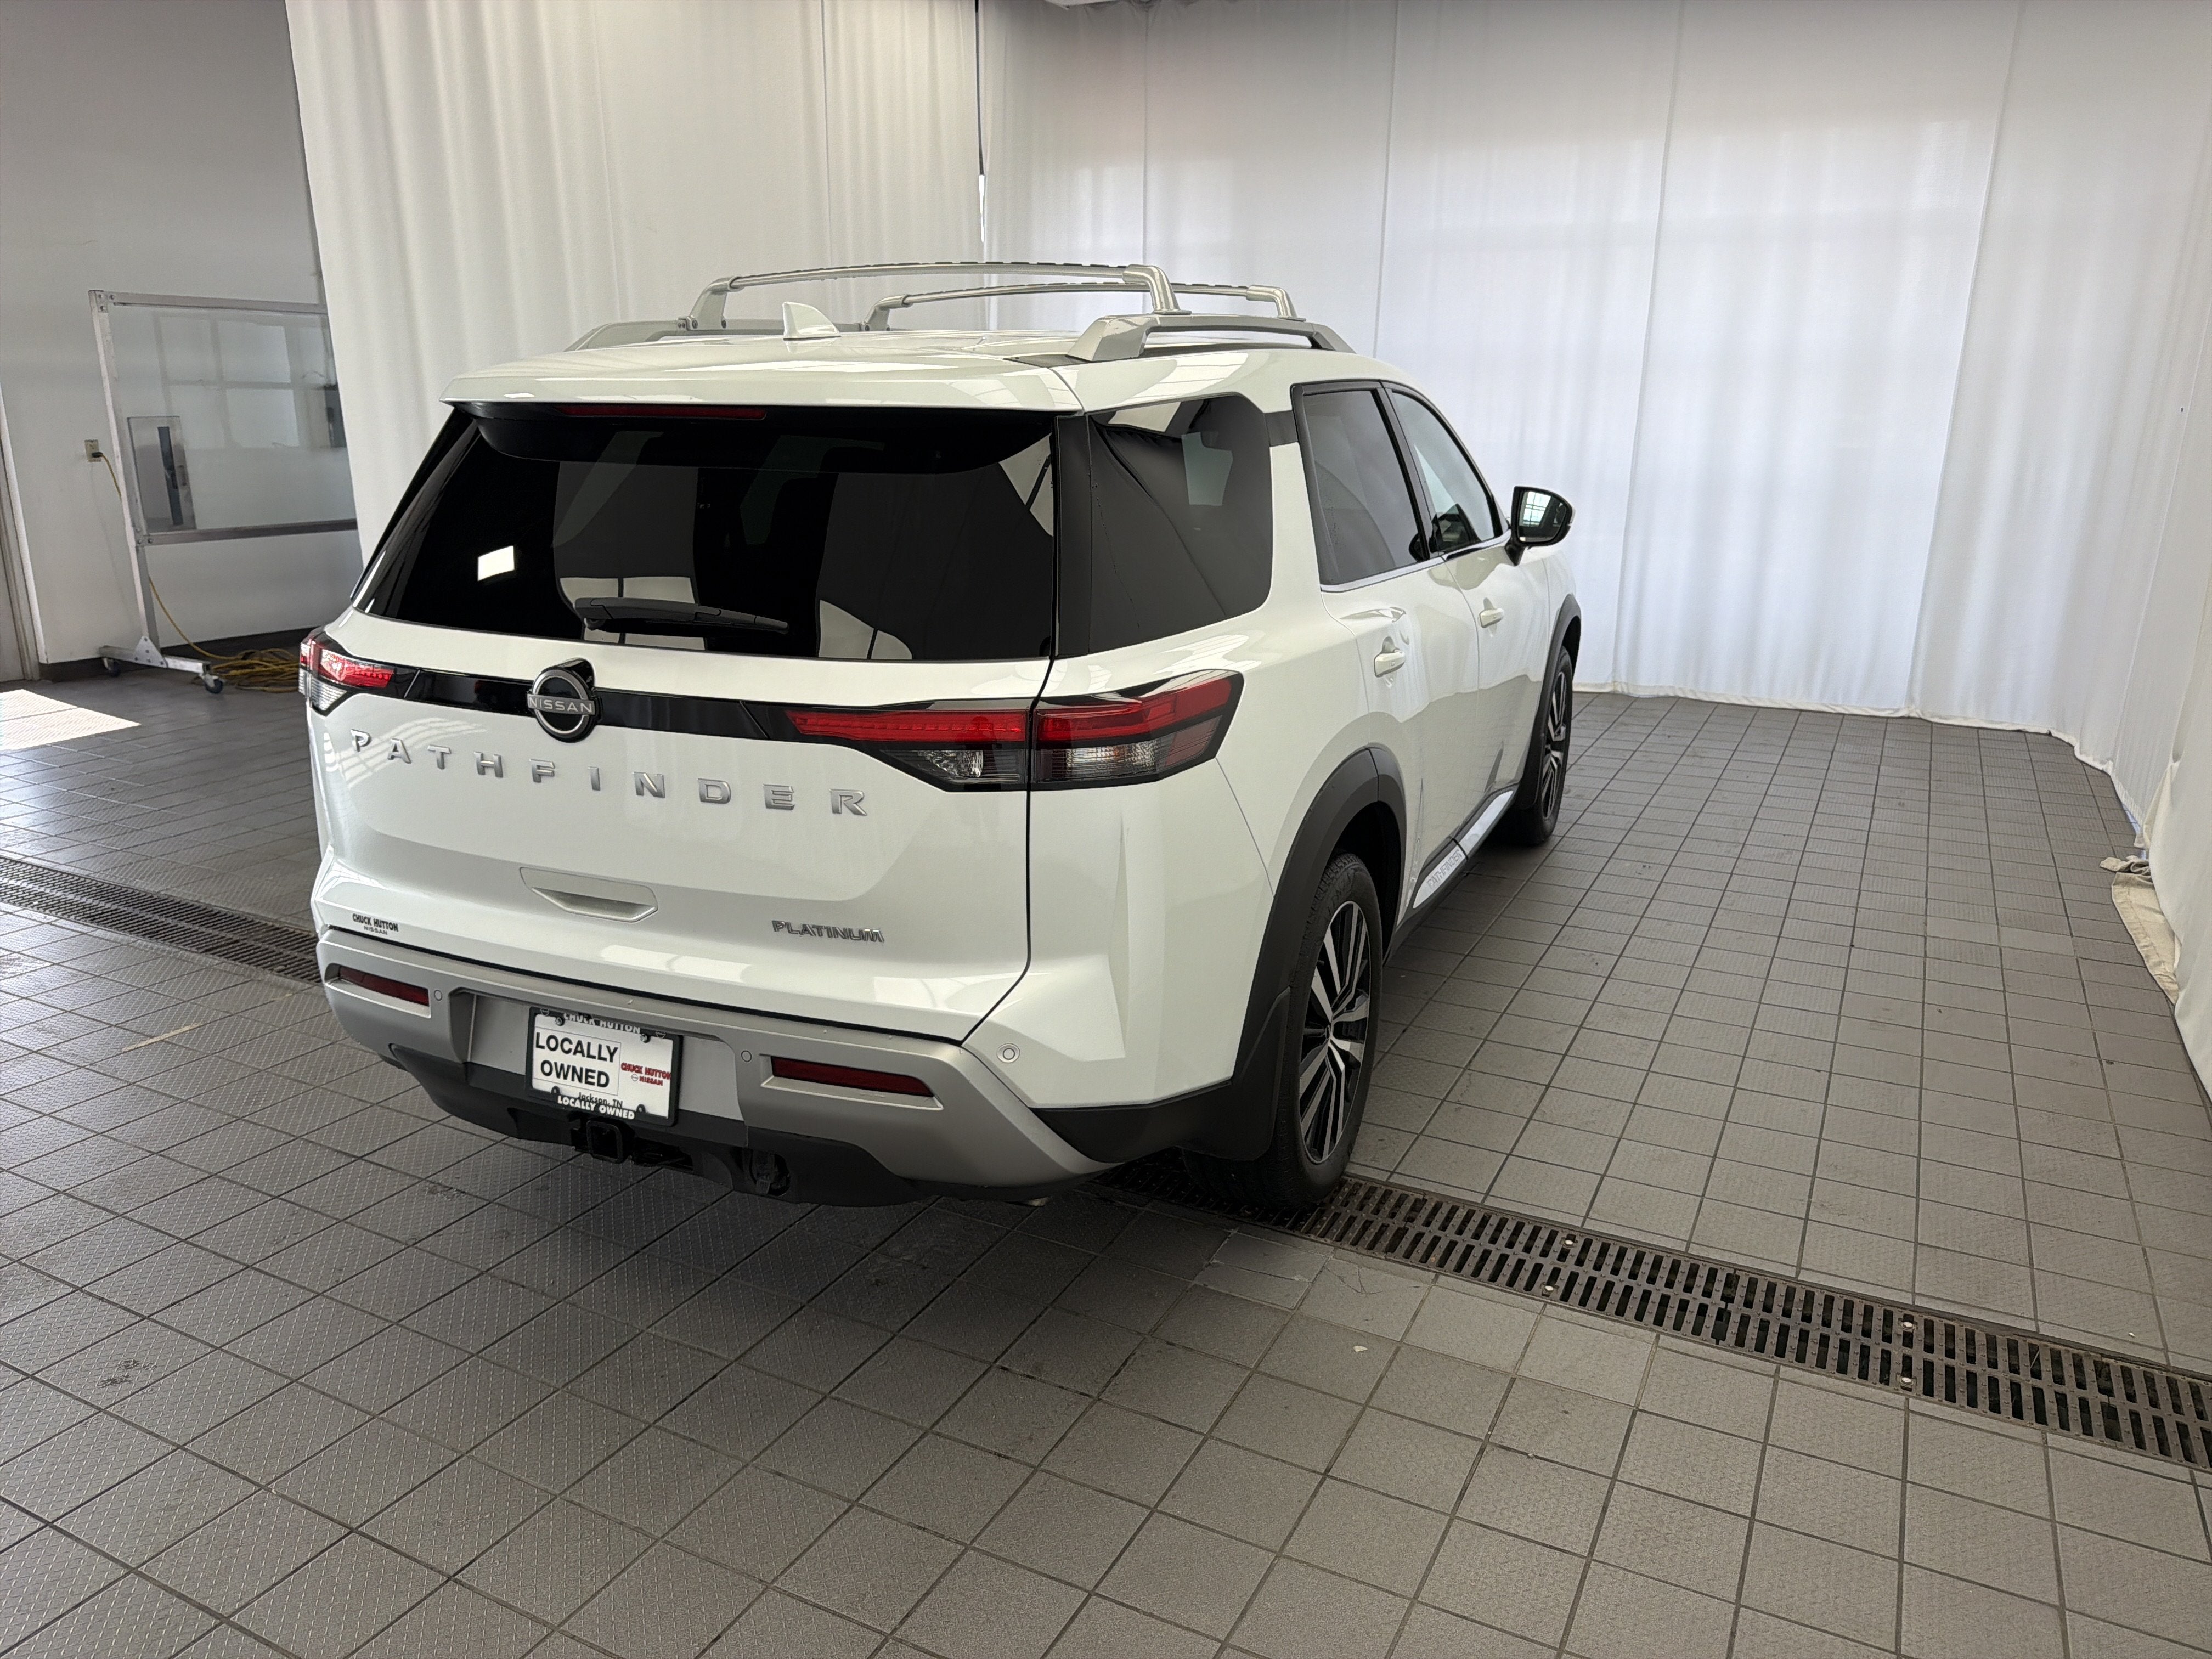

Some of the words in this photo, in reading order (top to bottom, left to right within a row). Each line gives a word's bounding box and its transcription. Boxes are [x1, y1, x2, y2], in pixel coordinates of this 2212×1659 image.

[529, 697, 592, 713] NISSAN
[351, 729, 867, 816] PATHFINDER
[352, 913, 372, 926] CHUCK
[373, 918, 399, 932] HUTTON
[363, 925, 388, 935] NISSAN
[771, 919, 885, 943] PLATINUM
[535, 1032, 619, 1063] LOCALLY
[540, 1059, 610, 1088] OWNED
[620, 1062, 644, 1075] CHUCK
[639, 1075, 663, 1086] NISSAN
[557, 1095, 596, 1111] LOCALLY
[599, 1104, 635, 1120] OWNED
[612, 1098, 623, 1108] TN
